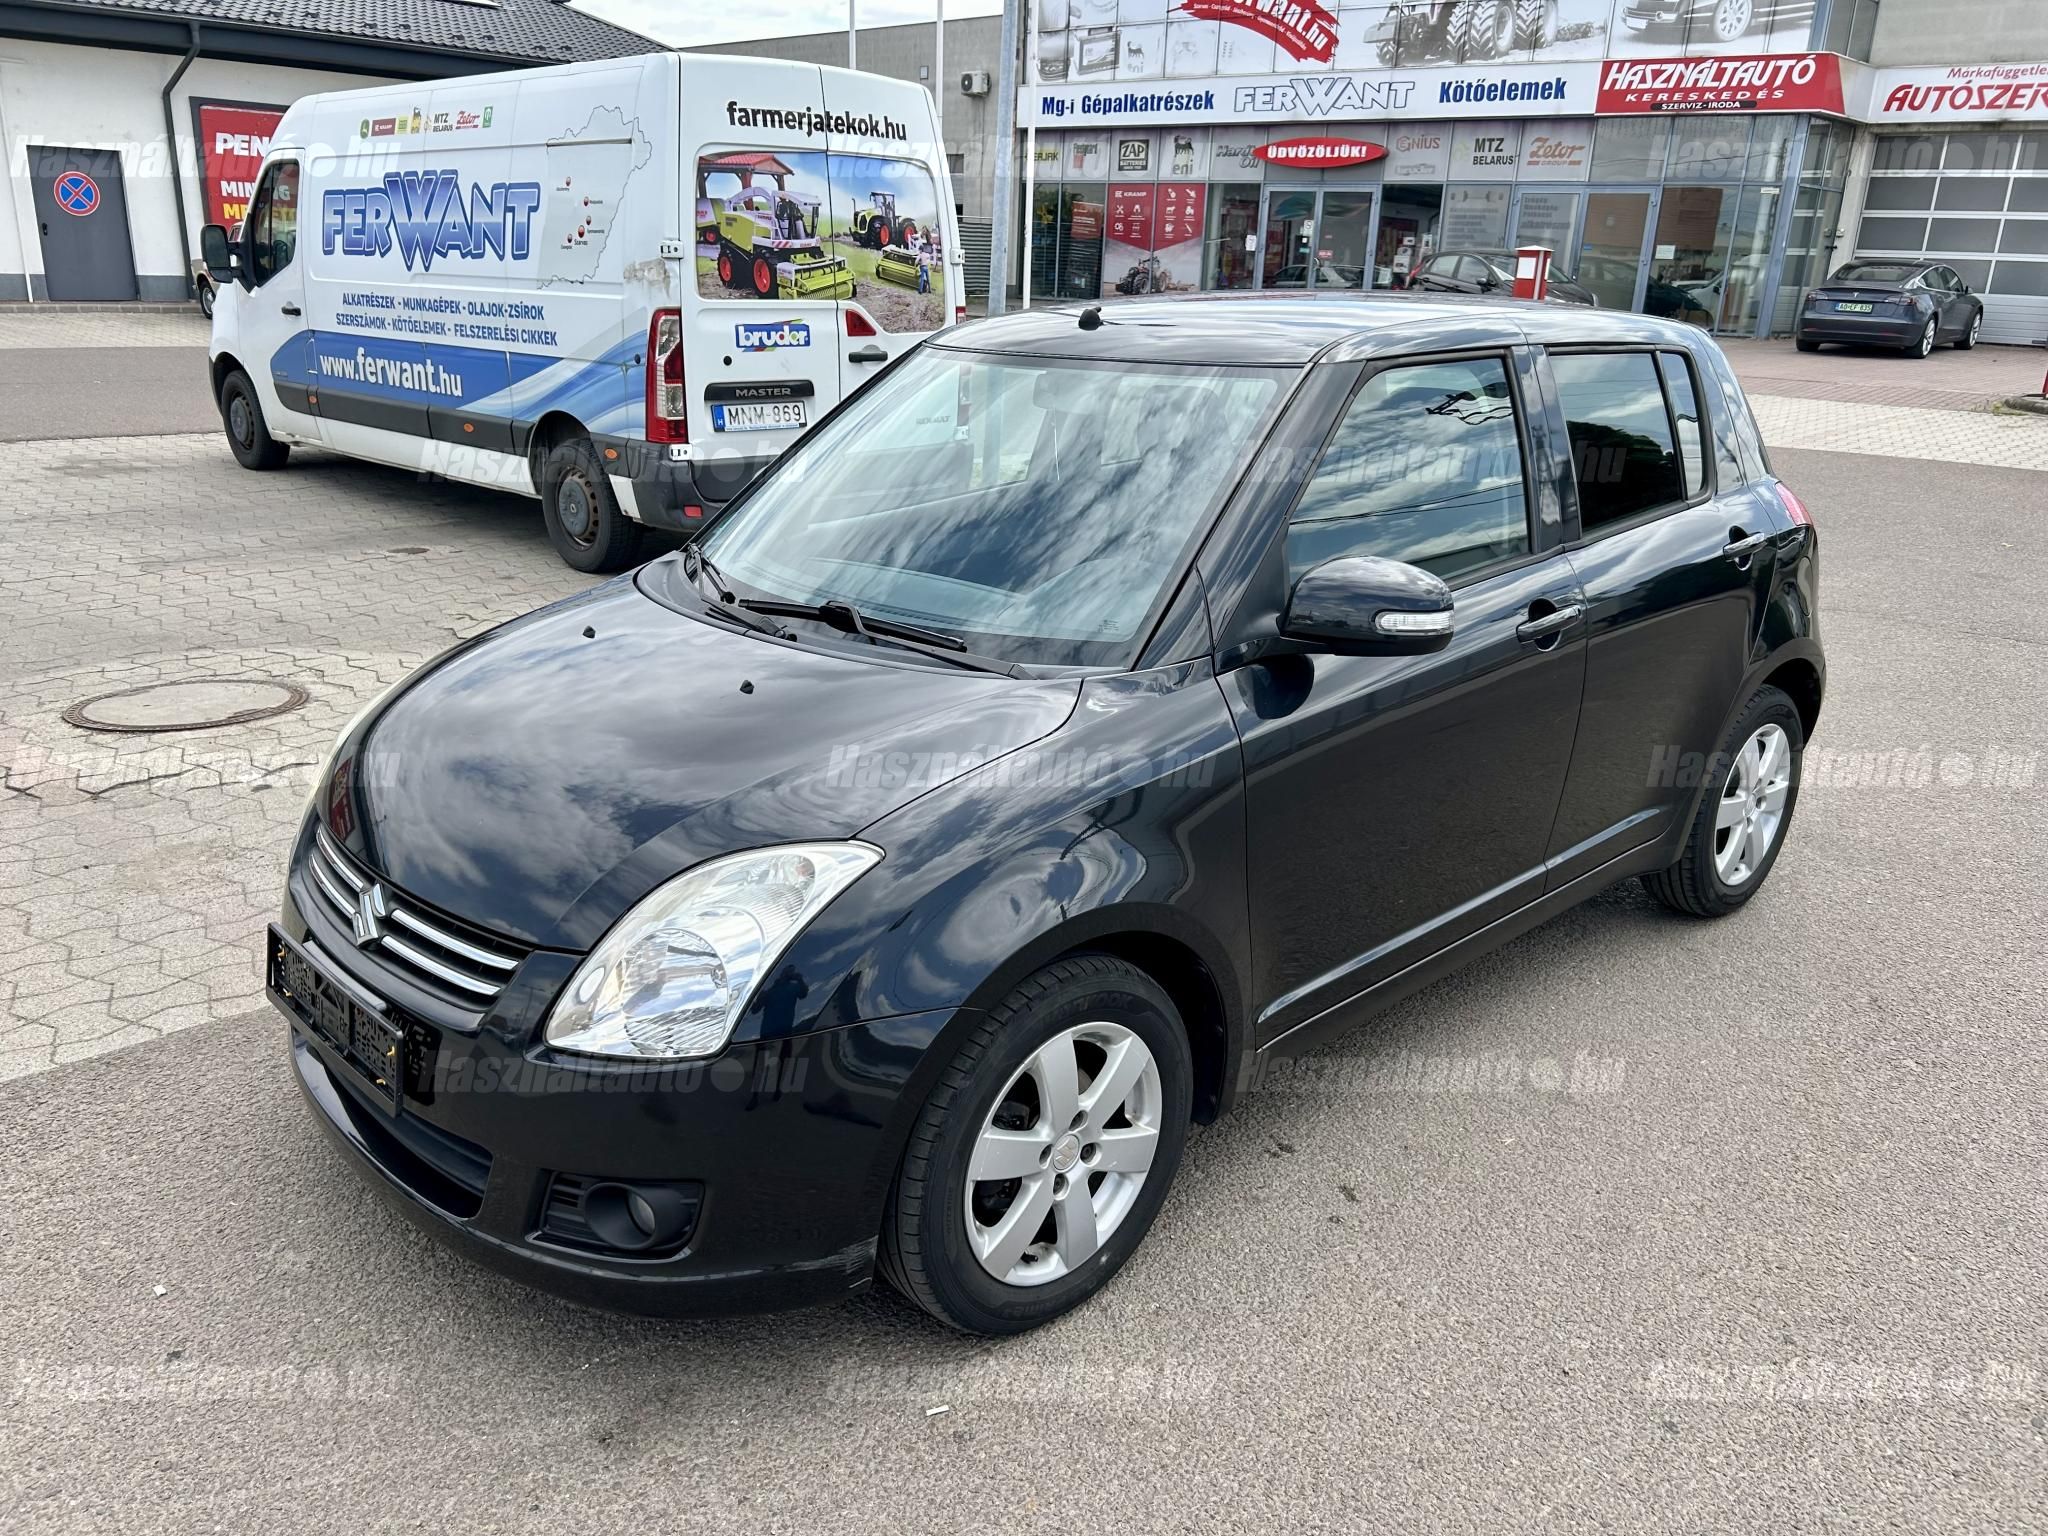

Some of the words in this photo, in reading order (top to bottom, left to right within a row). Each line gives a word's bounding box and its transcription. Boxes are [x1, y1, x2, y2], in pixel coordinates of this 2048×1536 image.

[1234, 0, 1328, 51] want.hu
[1603, 55, 1816, 91] HASZNÁLTAUTÓ
[1234, 77, 1415, 116] FERWANT
[1439, 76, 1567, 104] Kötőelemek
[1625, 88, 1785, 102] KERESKEDÉS
[1042, 96, 1075, 117] Mg-i
[1081, 90, 1215, 116] Gépalkatrészek
[432, 123, 453, 133] BELARUS
[433, 113, 449, 124] MTZ
[726, 101, 907, 141] farmerjatekok.hu
[215, 132, 271, 158] PEN
[1121, 143, 1145, 158] ZAP
[1267, 144, 1367, 159] ÜDVÖZÖLJÜK!
[1474, 137, 1505, 153] MTZ
[1528, 136, 1586, 159] Zetor
[1172, 159, 1194, 176] eni
[1472, 155, 1514, 166] BELARUS
[322, 169, 541, 272] FERWANT
[342, 291, 396, 309] ALKATRÉSZEK
[402, 296, 462, 315] MUNKAGÉPEK
[336, 312, 388, 331] SZERSZÁMOK
[454, 320, 520, 343] FELSZERELÉSI
[521, 329, 558, 347] CIKKEK
[738, 325, 808, 347] bruder
[320, 347, 463, 398] www.ferwant.hu
[735, 387, 792, 398] MASTER
[728, 404, 801, 426] MNM-869
